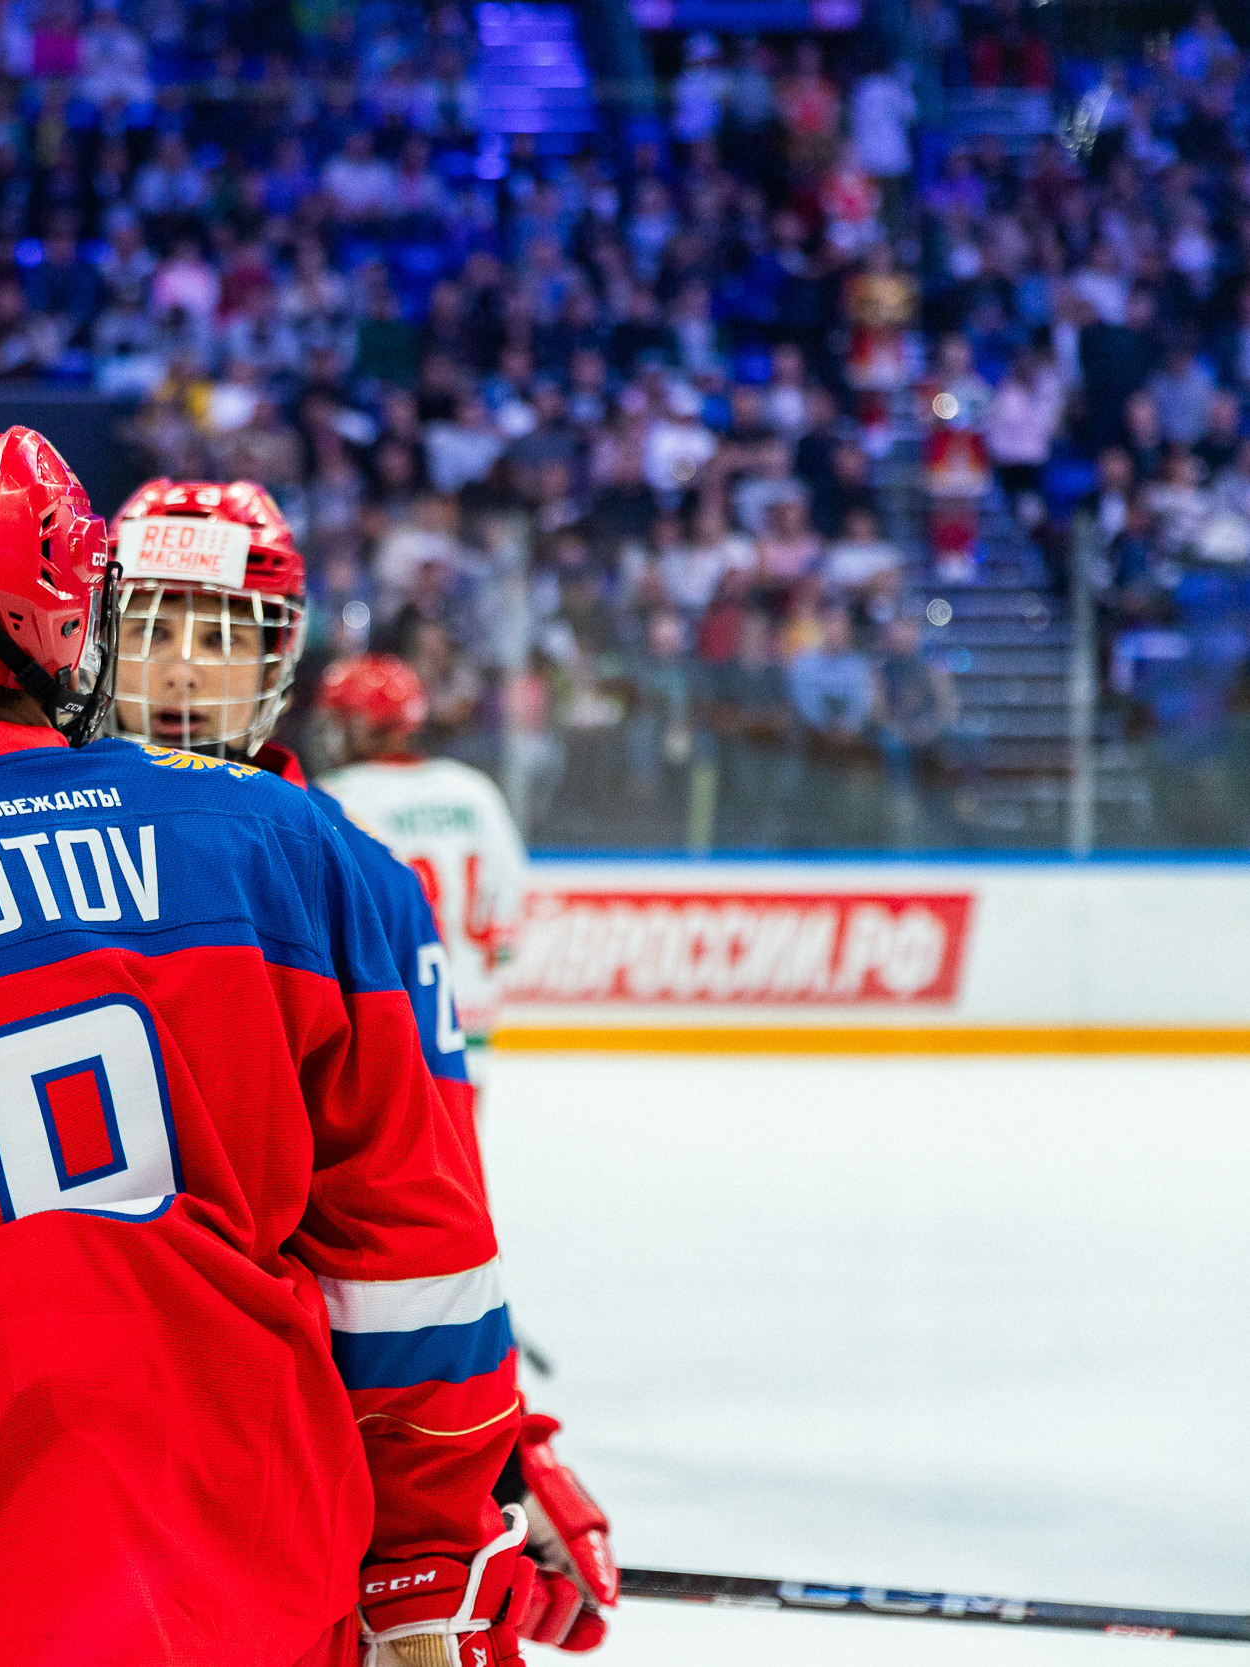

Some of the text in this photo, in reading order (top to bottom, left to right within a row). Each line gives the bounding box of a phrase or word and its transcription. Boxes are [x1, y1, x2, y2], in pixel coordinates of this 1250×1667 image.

[142, 526, 196, 550] RED
[91, 552, 108, 567] CC
[137, 550, 226, 573] MACHINE
[65, 702, 84, 713] CCM
[365, 1570, 437, 1595] CCM
